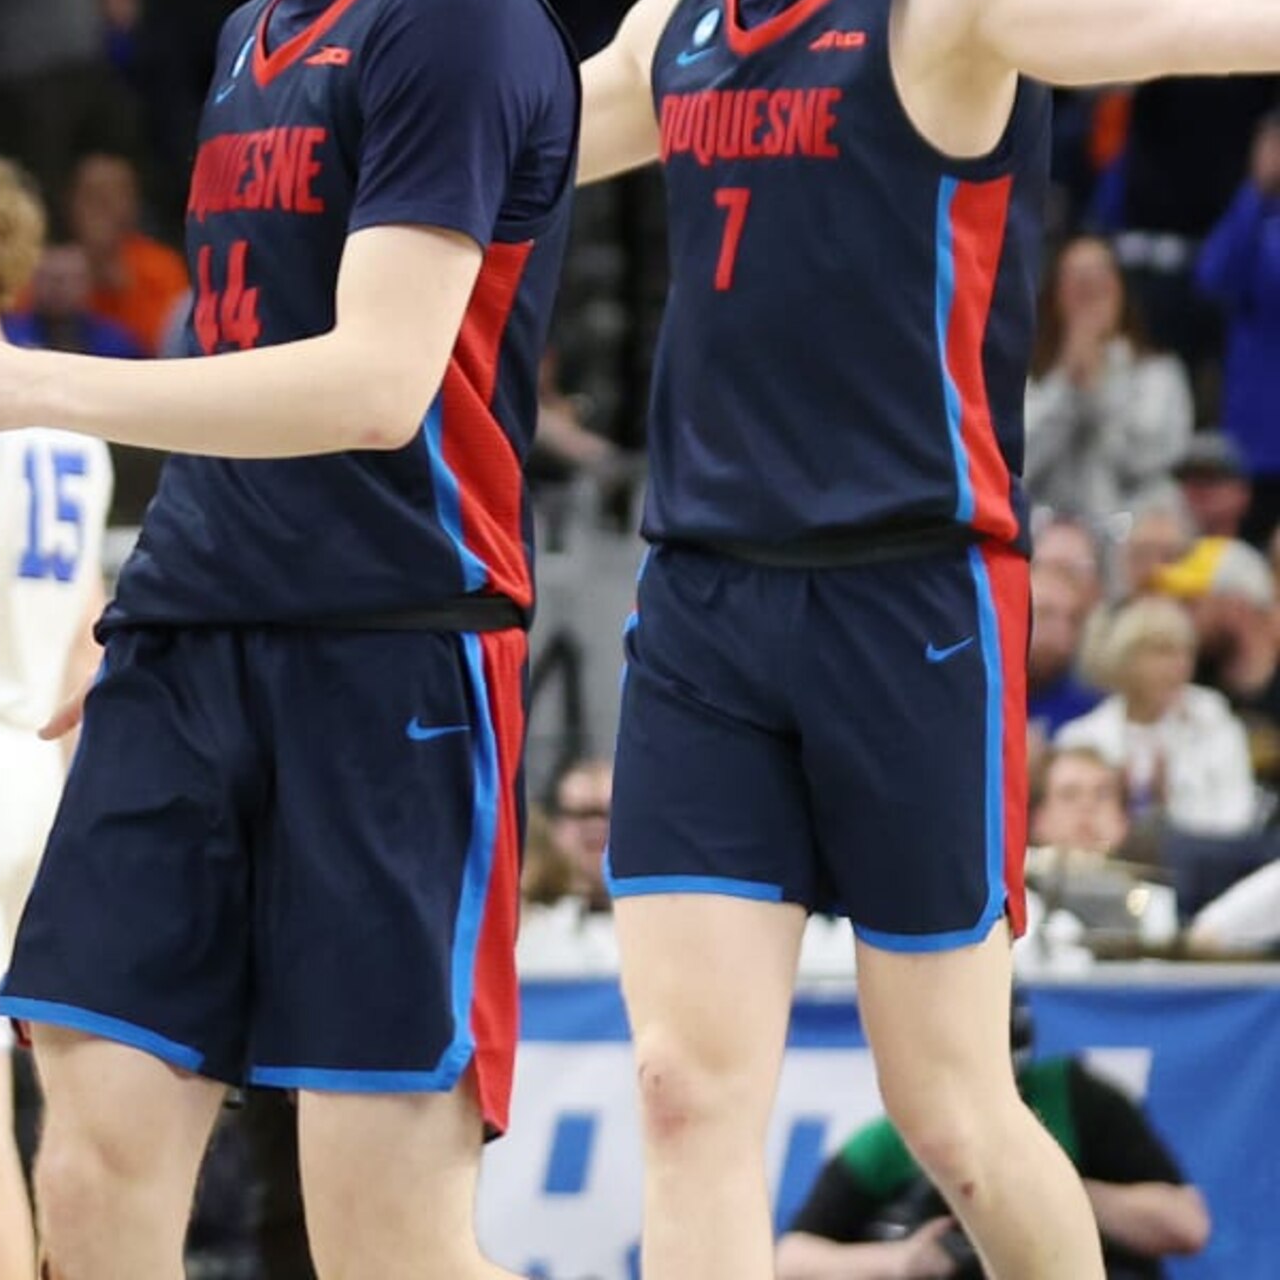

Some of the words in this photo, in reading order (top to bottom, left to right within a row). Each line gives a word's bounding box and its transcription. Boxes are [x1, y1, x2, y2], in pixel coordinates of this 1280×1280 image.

[659, 86, 843, 168] DUQUESNE
[712, 186, 752, 292] 7
[17, 444, 87, 583] 15
